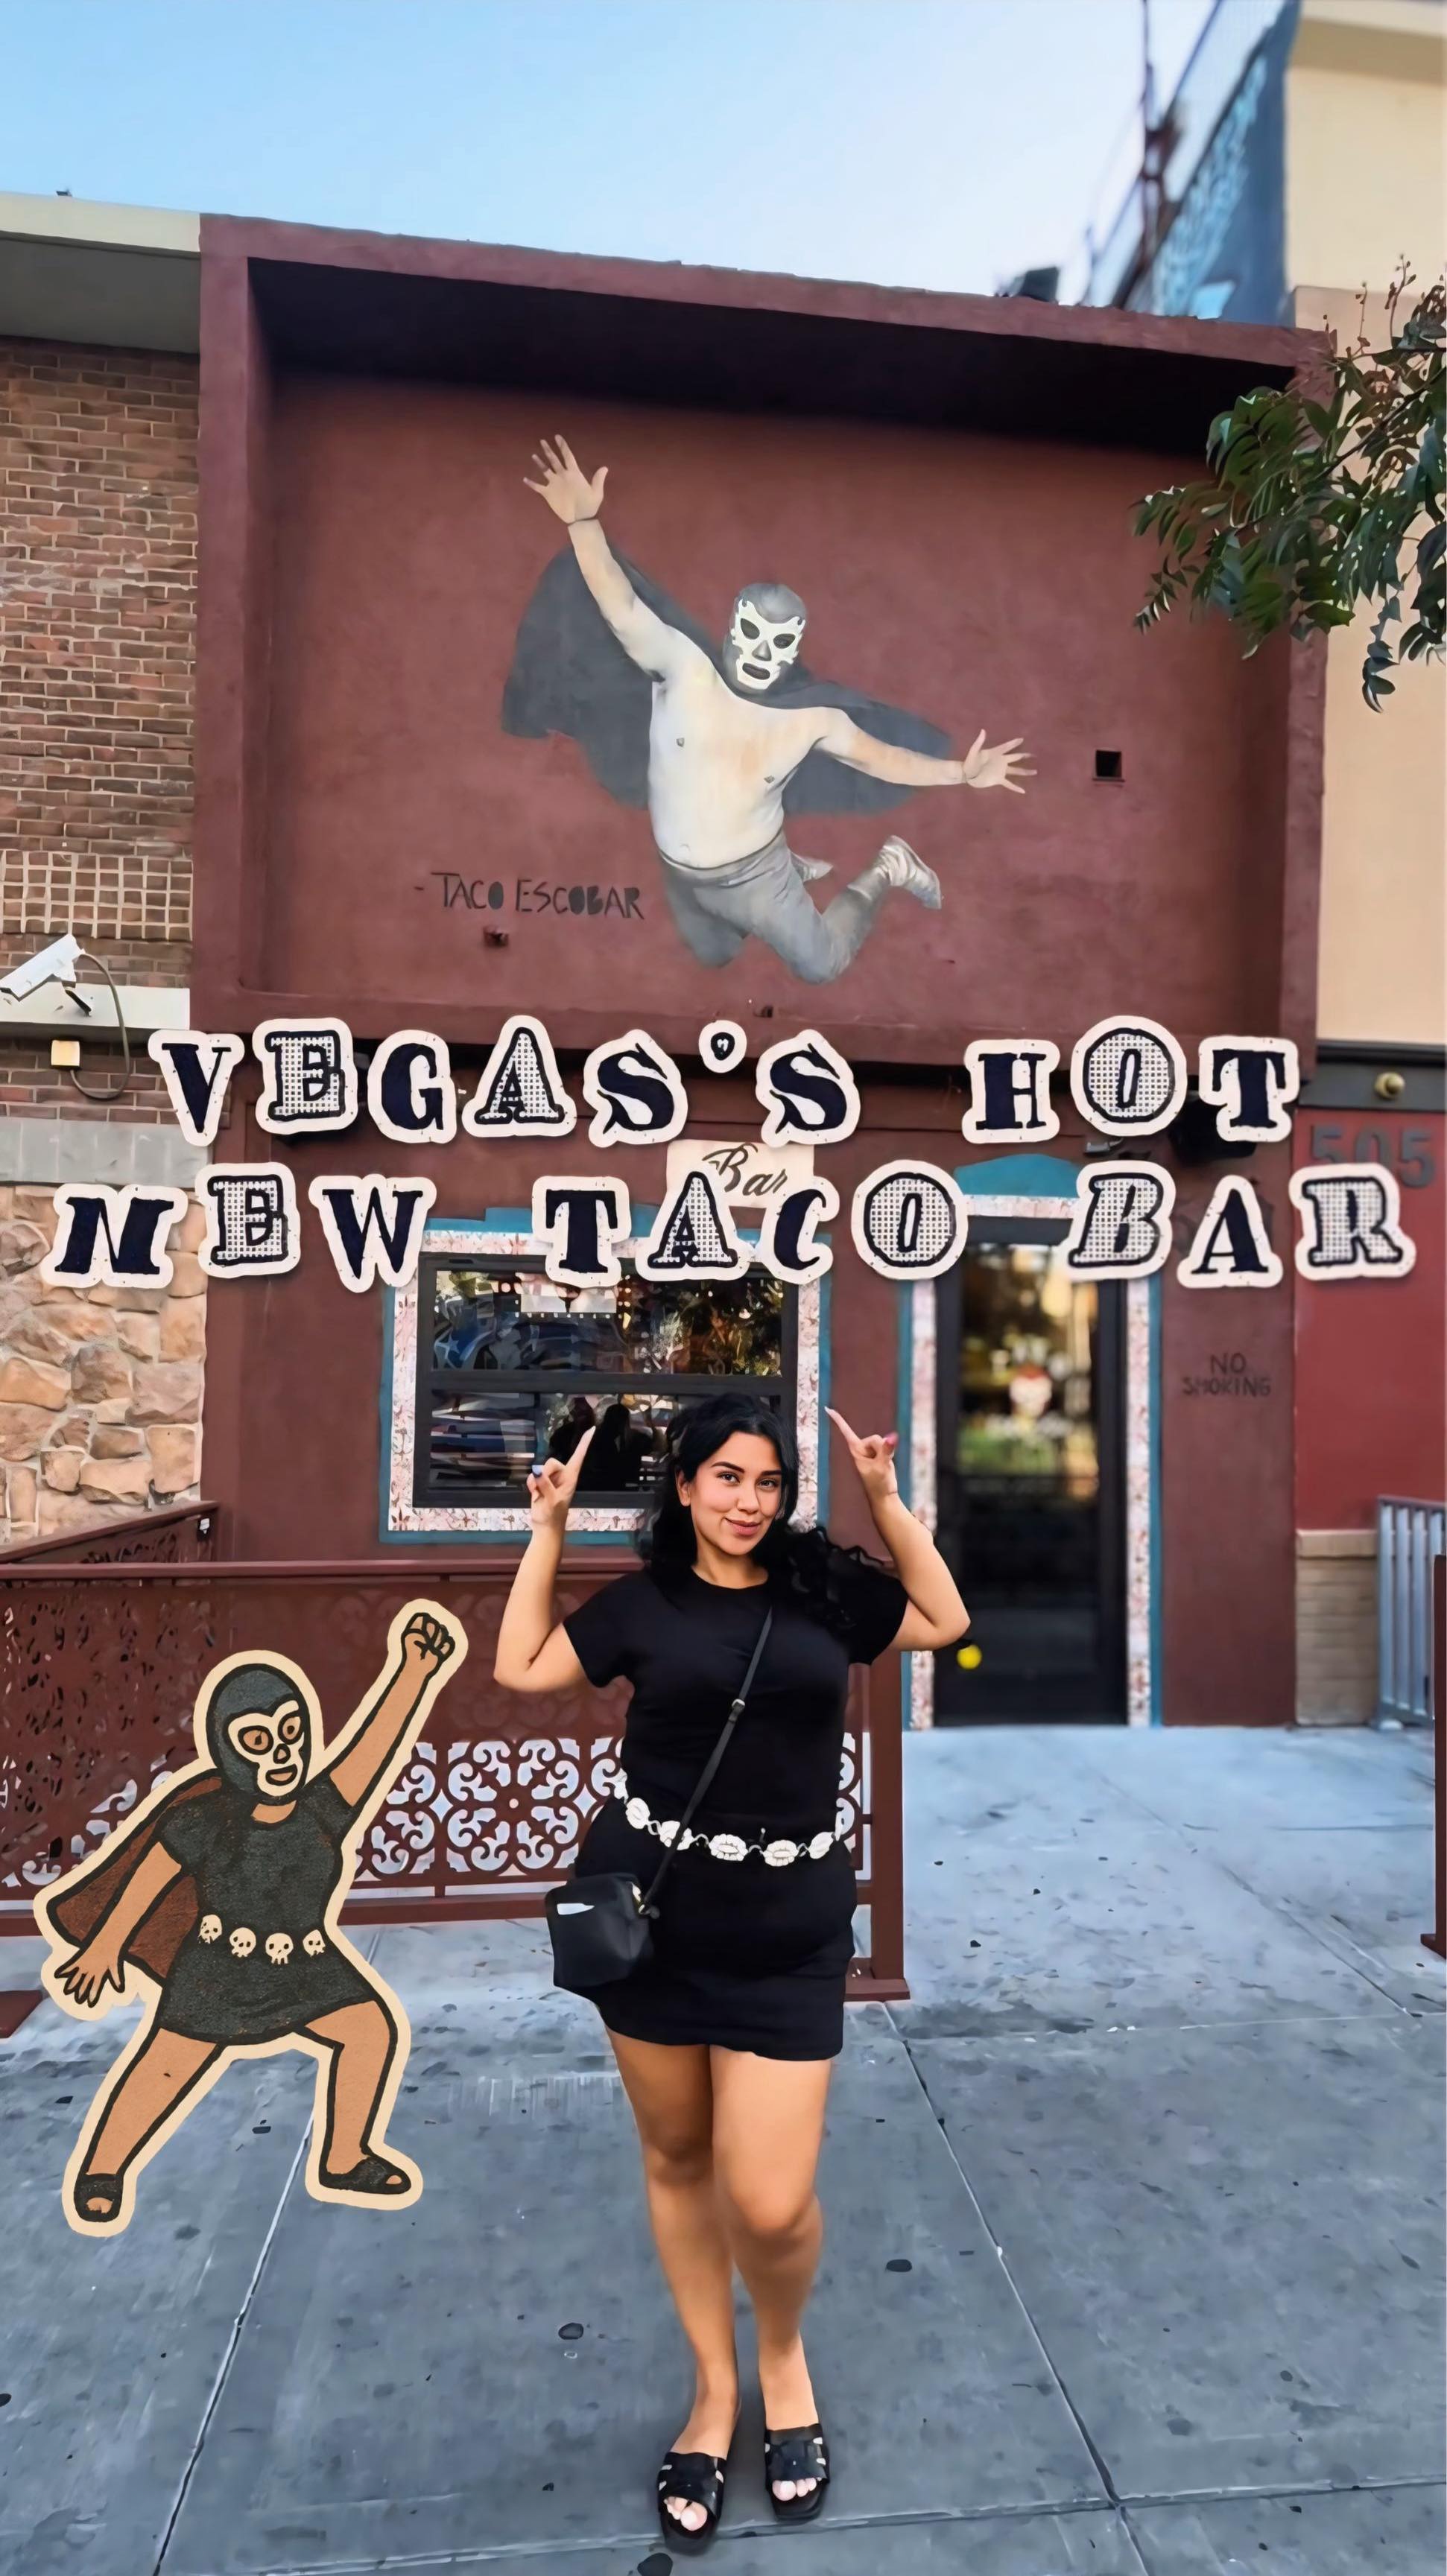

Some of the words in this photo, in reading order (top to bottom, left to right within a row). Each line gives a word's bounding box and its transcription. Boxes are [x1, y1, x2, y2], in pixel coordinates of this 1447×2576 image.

[431, 872, 505, 910] TACO
[516, 879, 645, 919] ESCOBAR
[702, 1143, 788, 1196] Bar
[1210, 1352, 1247, 1374] NO
[1182, 1377, 1271, 1397] SMOKING
